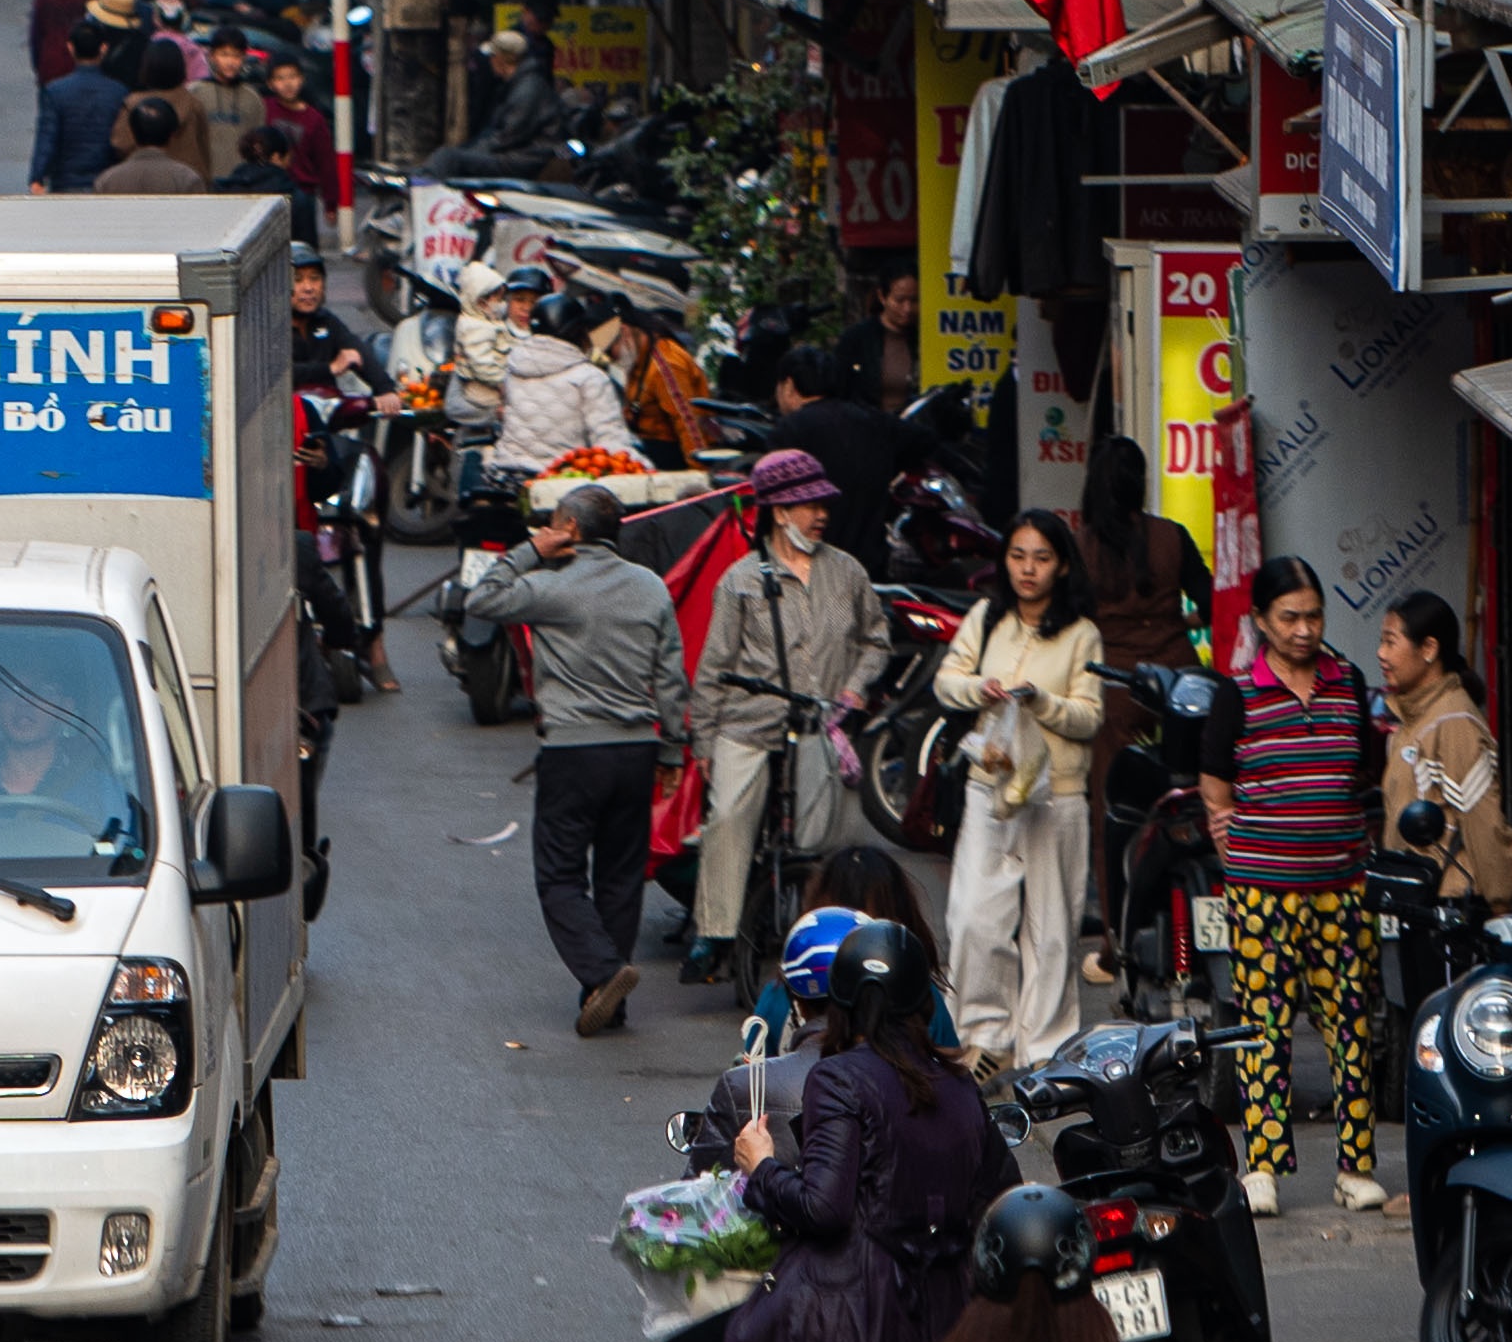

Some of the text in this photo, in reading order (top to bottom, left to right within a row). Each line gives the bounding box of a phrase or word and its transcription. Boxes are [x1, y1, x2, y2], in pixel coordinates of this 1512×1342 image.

[1166, 272, 1217, 306] 20
[939, 311, 1005, 343] NẠM
[947, 337, 1001, 372] SỐT
[4, 392, 67, 433] Bồ
[85, 400, 173, 434] Câu
[1333, 508, 1442, 613] LIONALU
